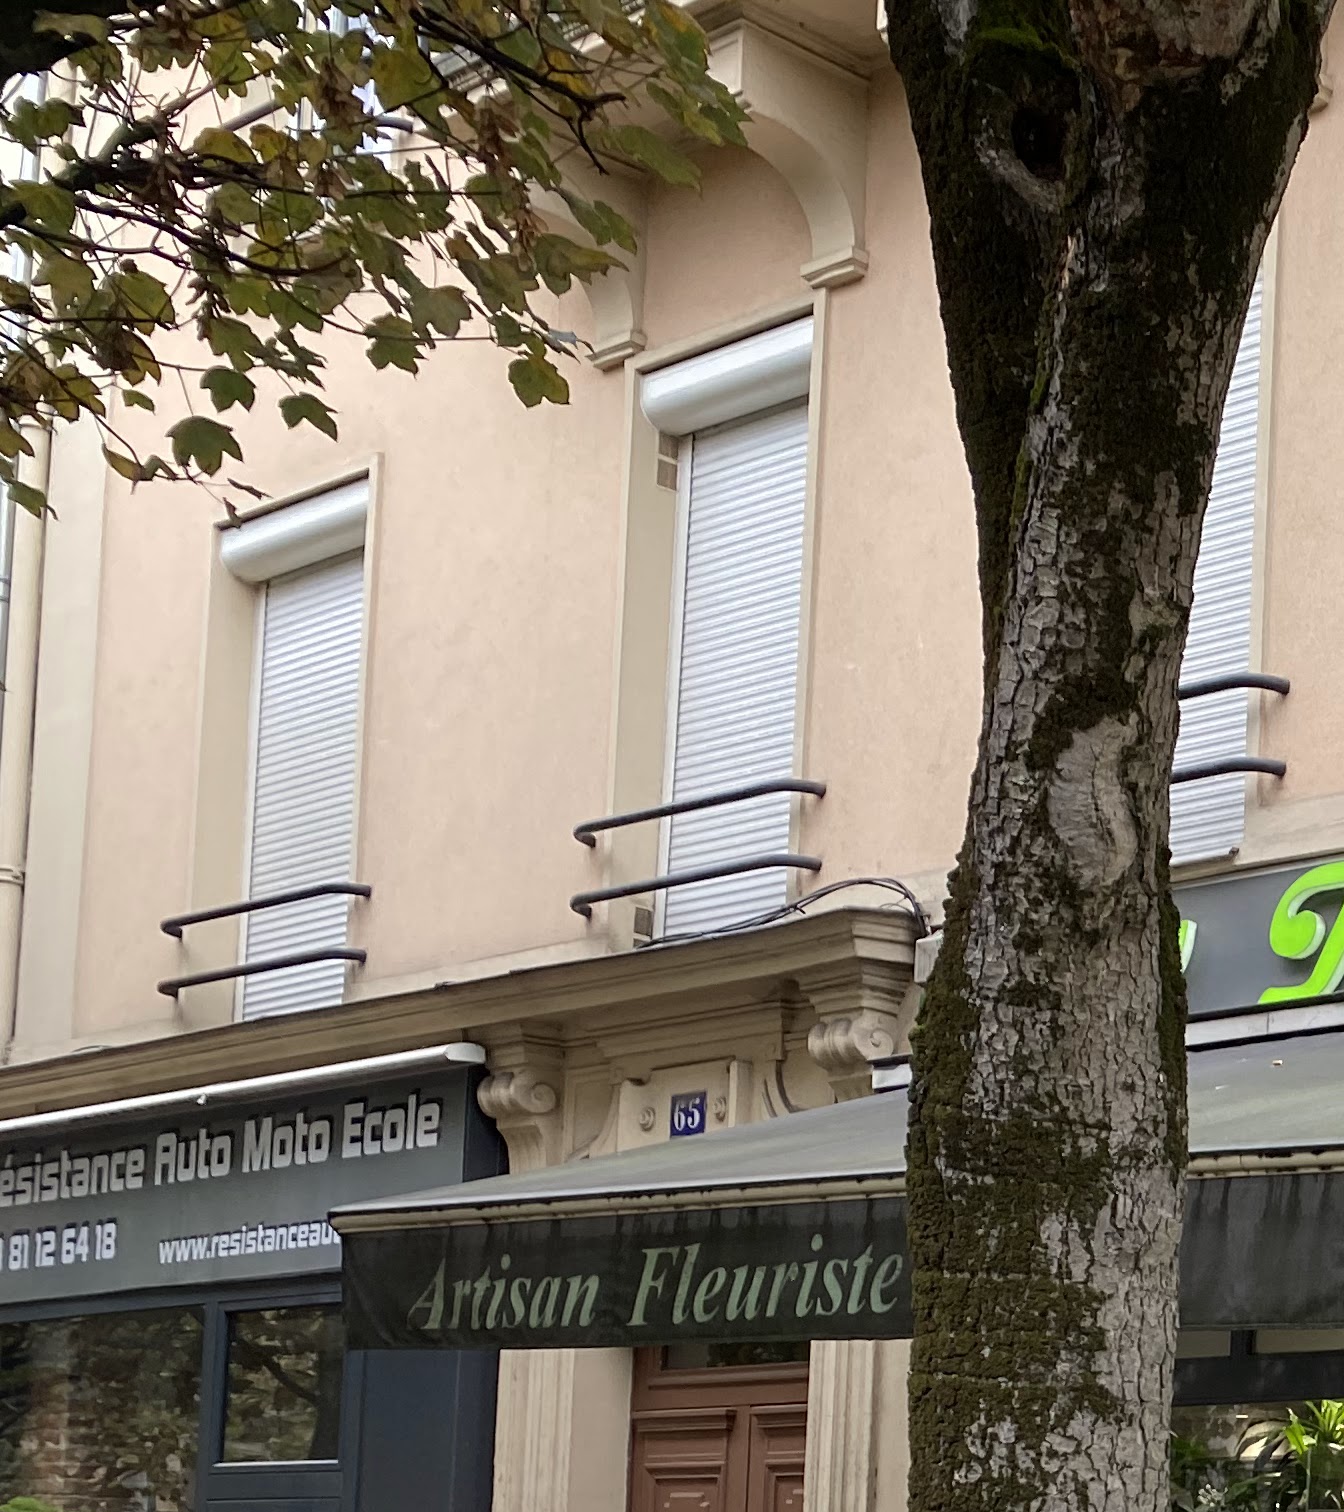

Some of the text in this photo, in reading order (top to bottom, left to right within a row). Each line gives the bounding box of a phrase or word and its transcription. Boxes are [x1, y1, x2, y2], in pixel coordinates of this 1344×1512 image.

[673, 1097, 701, 1132] 65
[154, 1128, 232, 1186] Auto
[241, 1112, 331, 1173] Moto
[341, 1093, 441, 1159] Ecole
[35, 1228, 56, 1267] 12
[61, 1222, 90, 1264] 64
[94, 1220, 117, 1260] 18
[159, 1220, 341, 1263] www.resistanceau
[407, 1233, 903, 1331] Artisan Fleuriste
